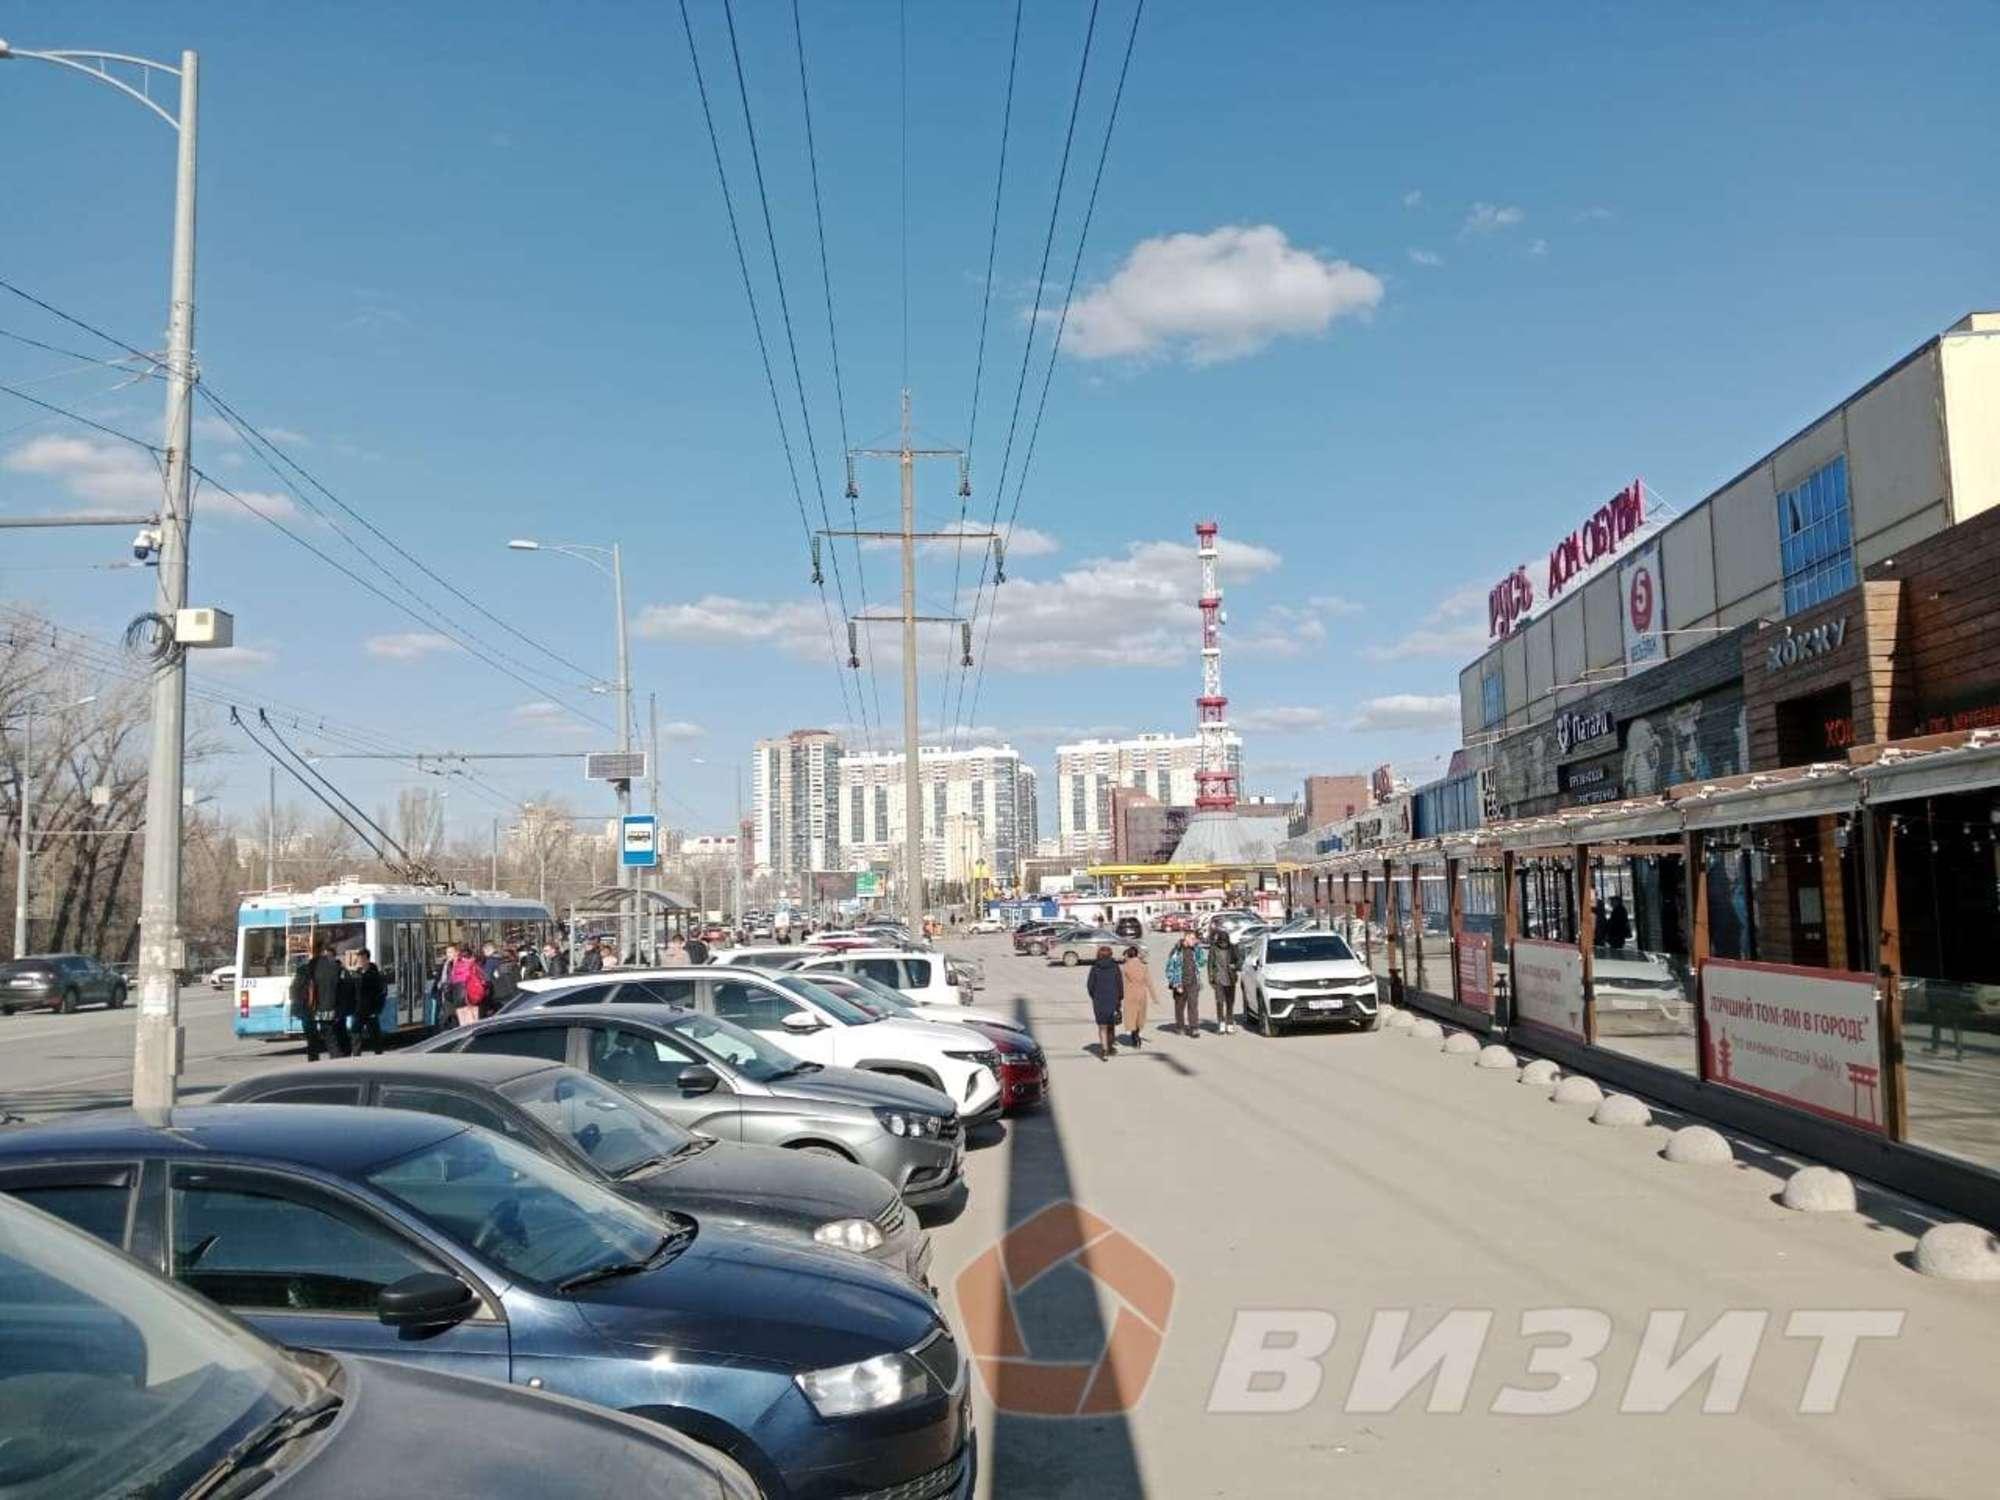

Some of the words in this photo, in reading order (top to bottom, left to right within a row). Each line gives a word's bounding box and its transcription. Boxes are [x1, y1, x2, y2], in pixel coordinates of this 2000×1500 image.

[1583, 477, 1645, 564] ОБУВИ
[1711, 995, 1754, 1020] ЛУЧШИЙ
[1755, 1003, 1801, 1029] ТОМ-ЯМ
[1803, 1011, 1813, 1032] В
